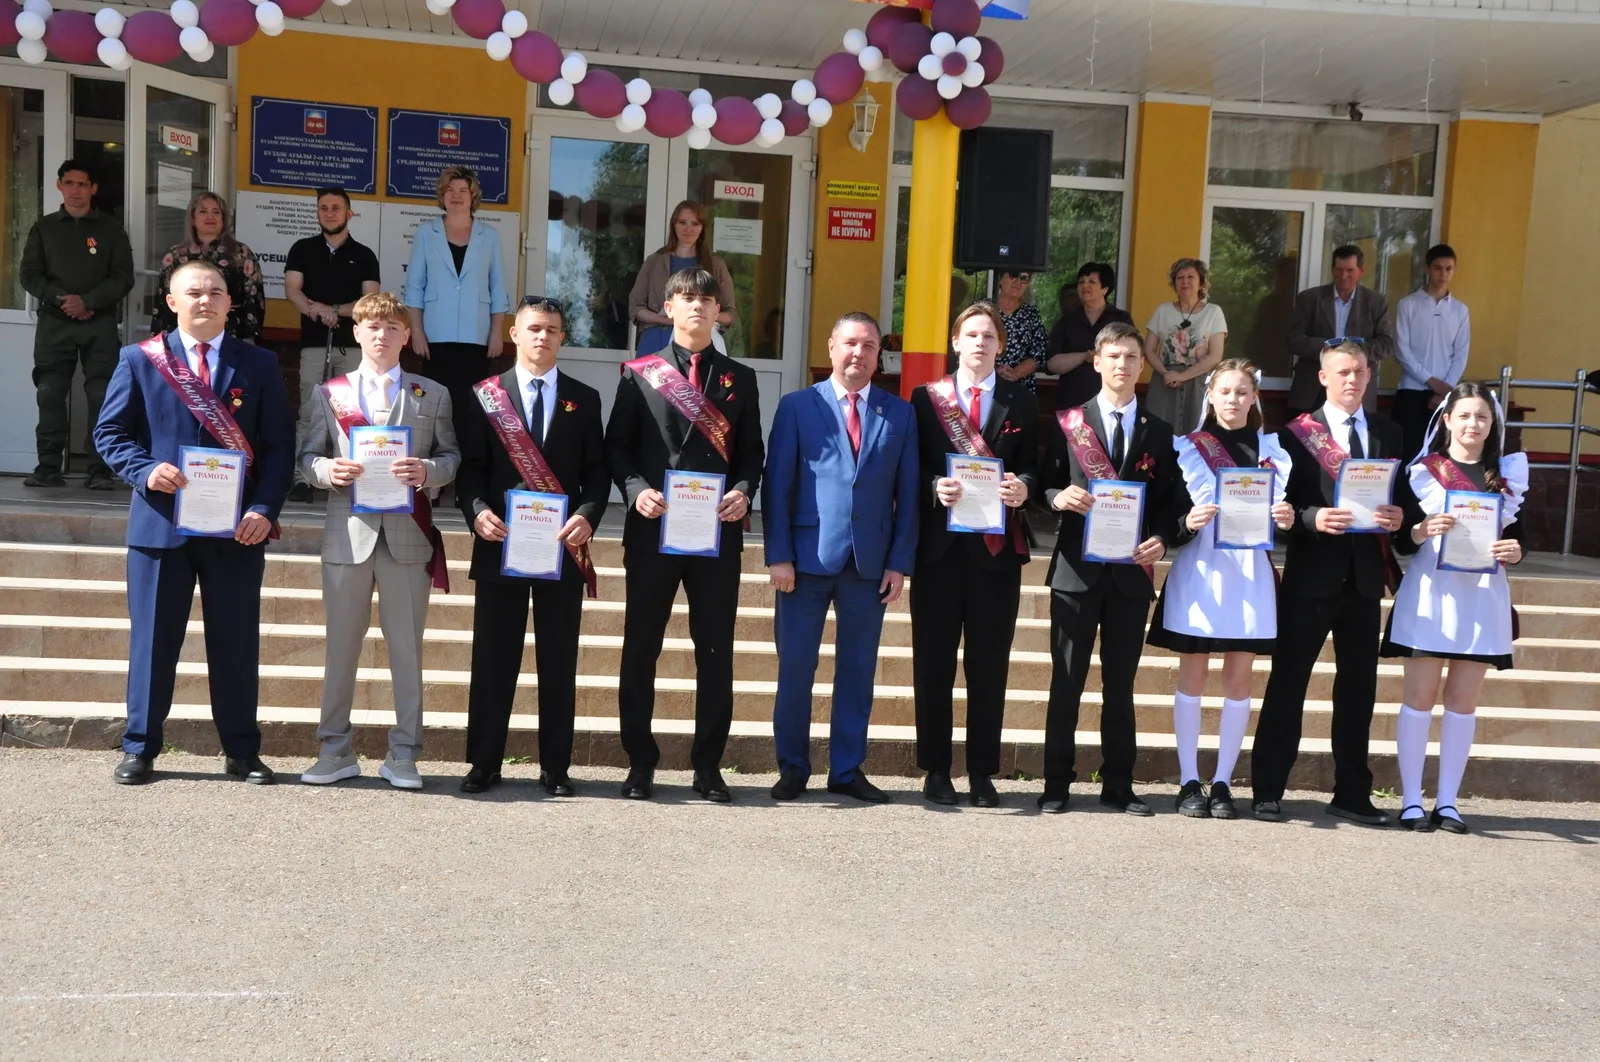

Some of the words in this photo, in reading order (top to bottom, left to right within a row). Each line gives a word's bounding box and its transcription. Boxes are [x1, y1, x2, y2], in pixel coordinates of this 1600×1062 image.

[170, 132, 192, 147] ВХОД
[724, 184, 754, 198] ВХОД
[841, 211, 872, 219] ТЕРРИТОРИИ
[832, 226, 840, 236] НЕ
[842, 227, 871, 238] КУРИТЬ!
[194, 472, 228, 480] ГРАМОТА
[1101, 502, 1131, 510] ГРАМОТА
[520, 514, 552, 523] ГРАМОТА
